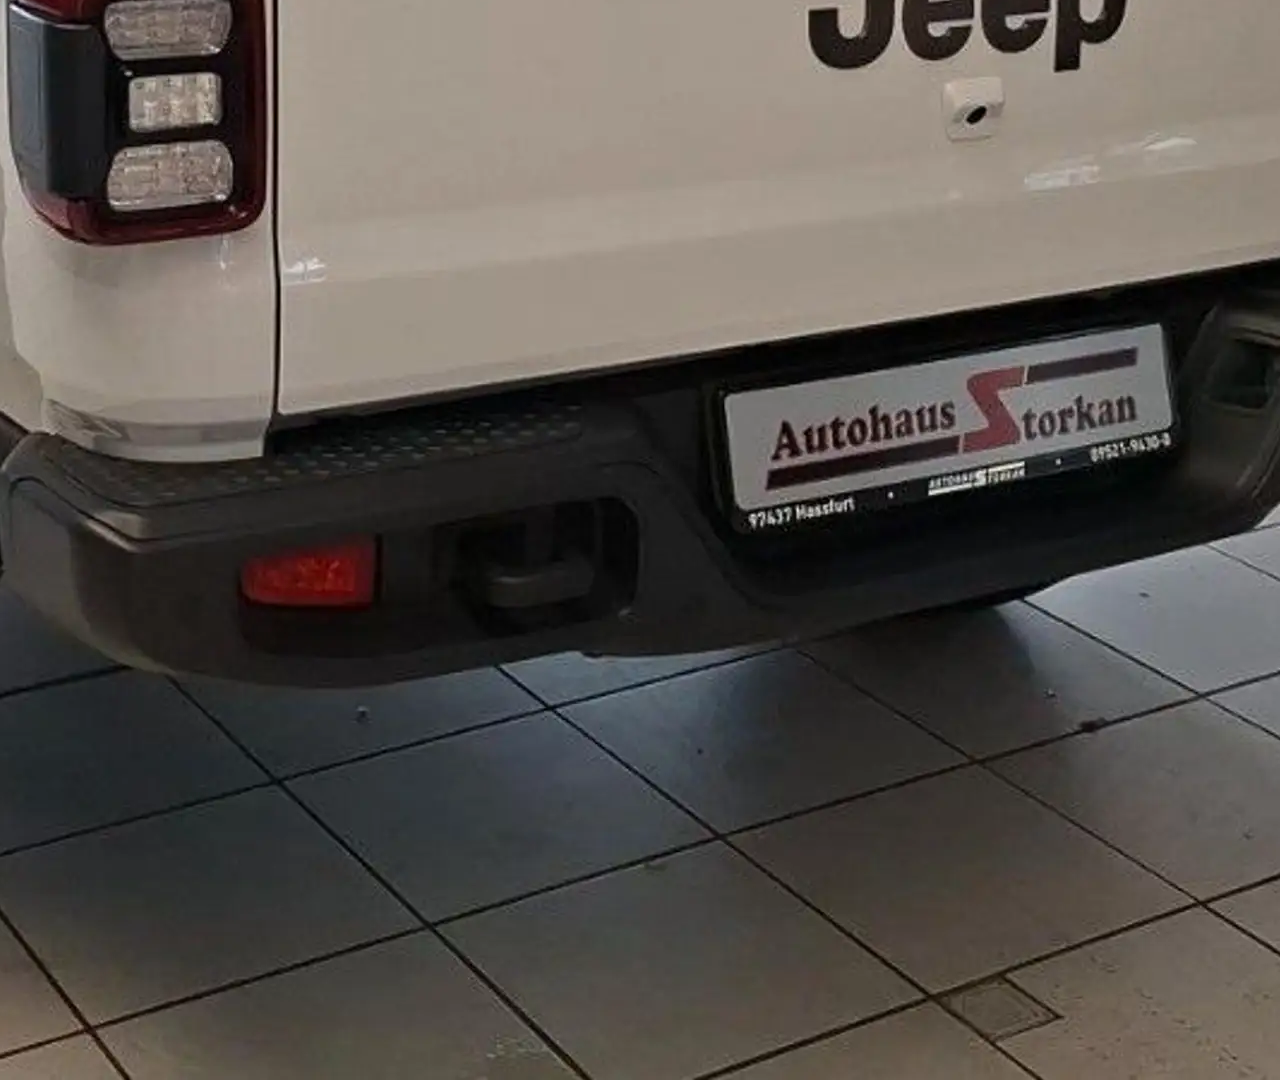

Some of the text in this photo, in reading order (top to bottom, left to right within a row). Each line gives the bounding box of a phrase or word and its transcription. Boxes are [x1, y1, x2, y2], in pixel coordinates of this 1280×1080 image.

[771, 366, 1137, 461] Autohaus Storkan
[748, 508, 793, 532] 97437
